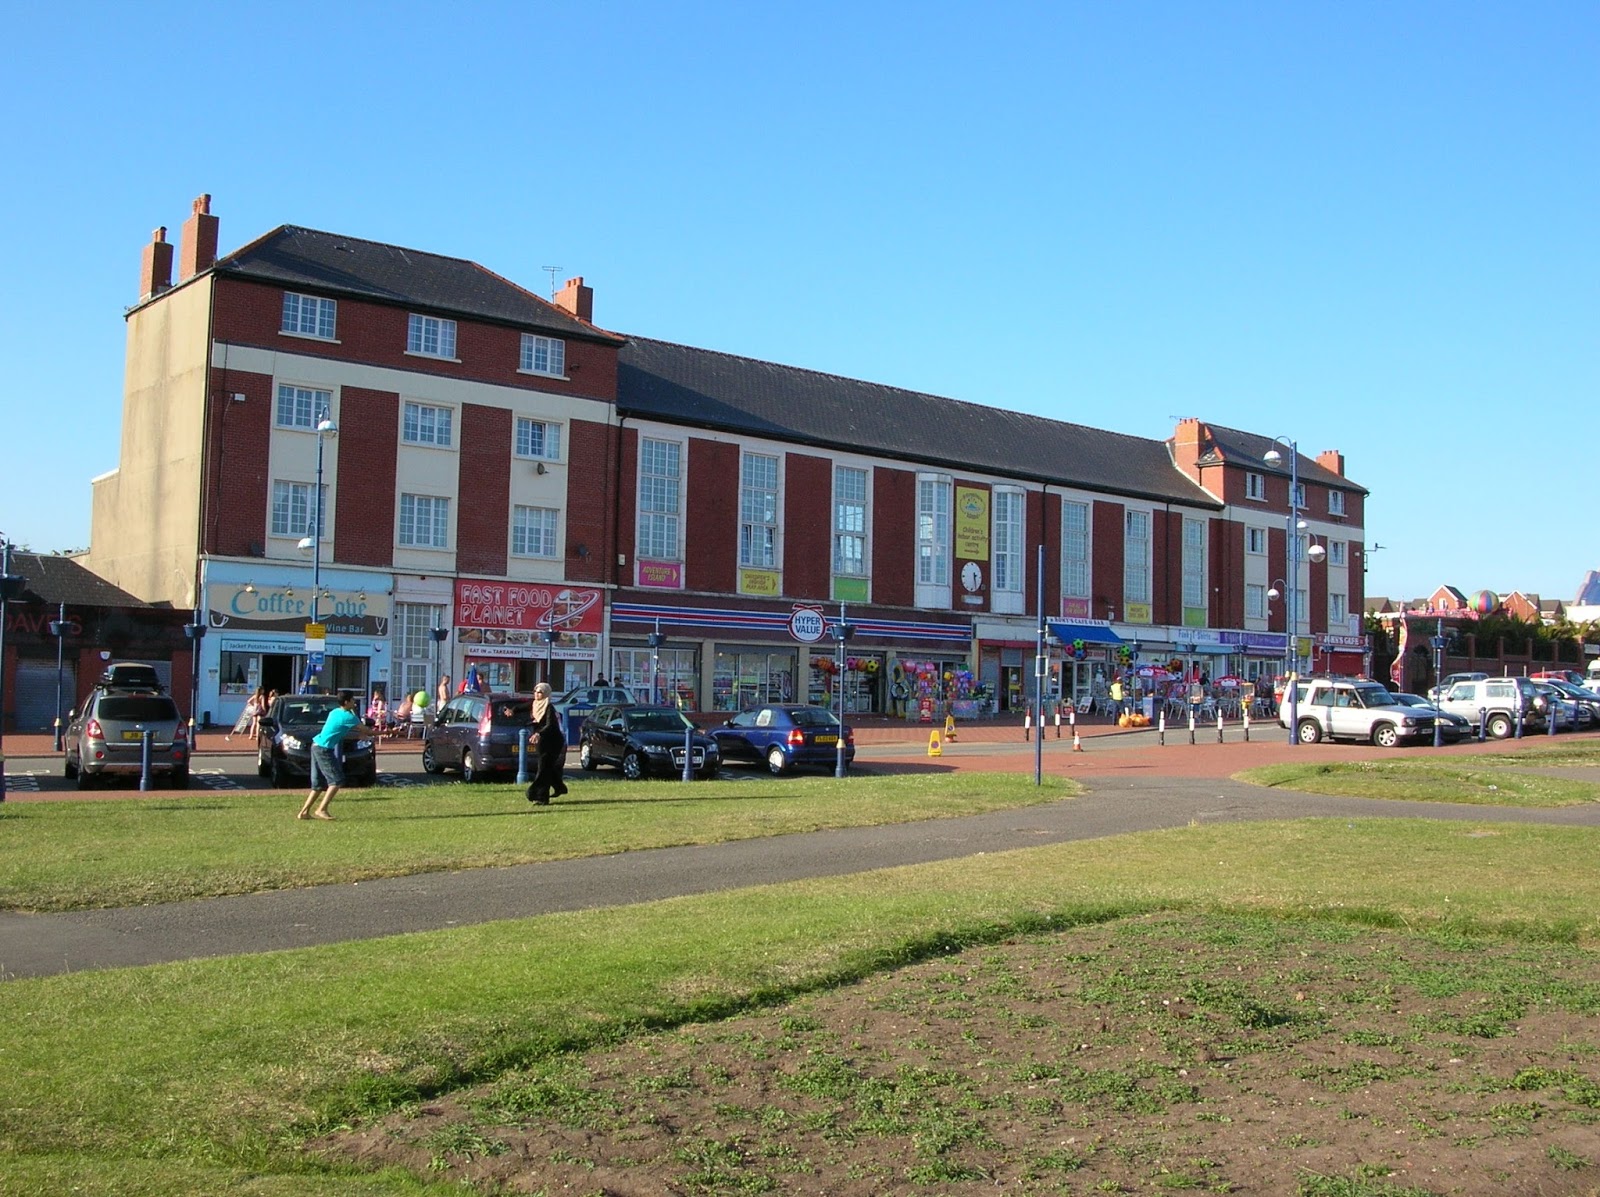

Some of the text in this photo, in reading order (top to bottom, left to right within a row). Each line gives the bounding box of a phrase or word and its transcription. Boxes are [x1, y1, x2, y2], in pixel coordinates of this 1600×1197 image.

[461, 584, 552, 608] FAST FOOD
[231, 590, 368, 621] Coffee Cove
[460, 604, 525, 626] PLANET
[795, 615, 820, 625] HYPER
[349, 625, 365, 634] Bar
[795, 625, 820, 634] VALUE
